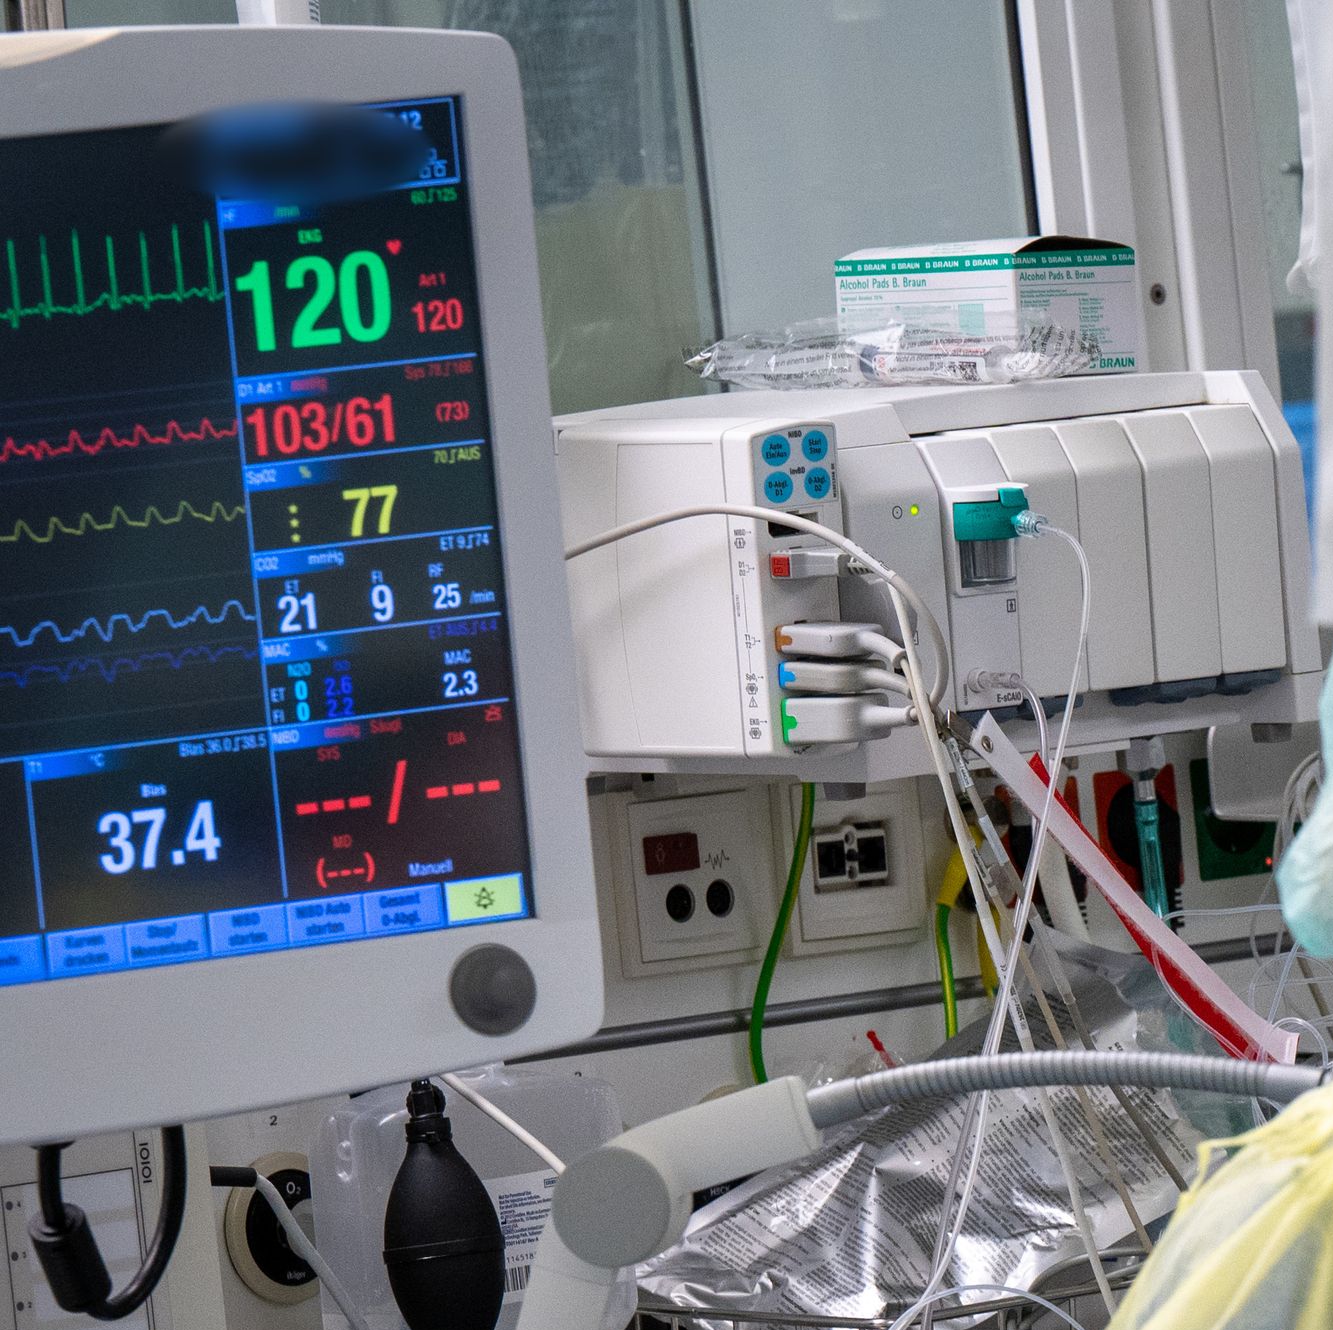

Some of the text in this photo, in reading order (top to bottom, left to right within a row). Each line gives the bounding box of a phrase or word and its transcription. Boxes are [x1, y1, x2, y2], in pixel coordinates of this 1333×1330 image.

[864, 263, 887, 271] BRAUN
[898, 262, 920, 270] BRAUN
[932, 260, 959, 268] BRAUN
[972, 258, 999, 267] BRAUN
[1019, 270, 1095, 281] Alcohol Pads B. Braun
[839, 276, 927, 290] Alcohol Pads B. Braun
[235, 250, 392, 352] 120
[411, 298, 465, 333] 120
[1100, 357, 1135, 369] BRAUN
[436, 401, 470, 423] (73)
[247, 393, 396, 457] 103/61
[342, 484, 398, 537] 77
[277, 592, 318, 634] 21
[371, 583, 396, 622] 9
[432, 582, 462, 611] 25
[294, 680, 309, 701] 0
[324, 675, 353, 697] 2.6
[442, 670, 479, 698] 2.3
[296, 701, 311, 722] 0
[326, 697, 355, 718] 2.2
[96, 800, 222, 875] 37.4
[408, 859, 453, 878] Manuell
[269, 1114, 279, 1127] 2
